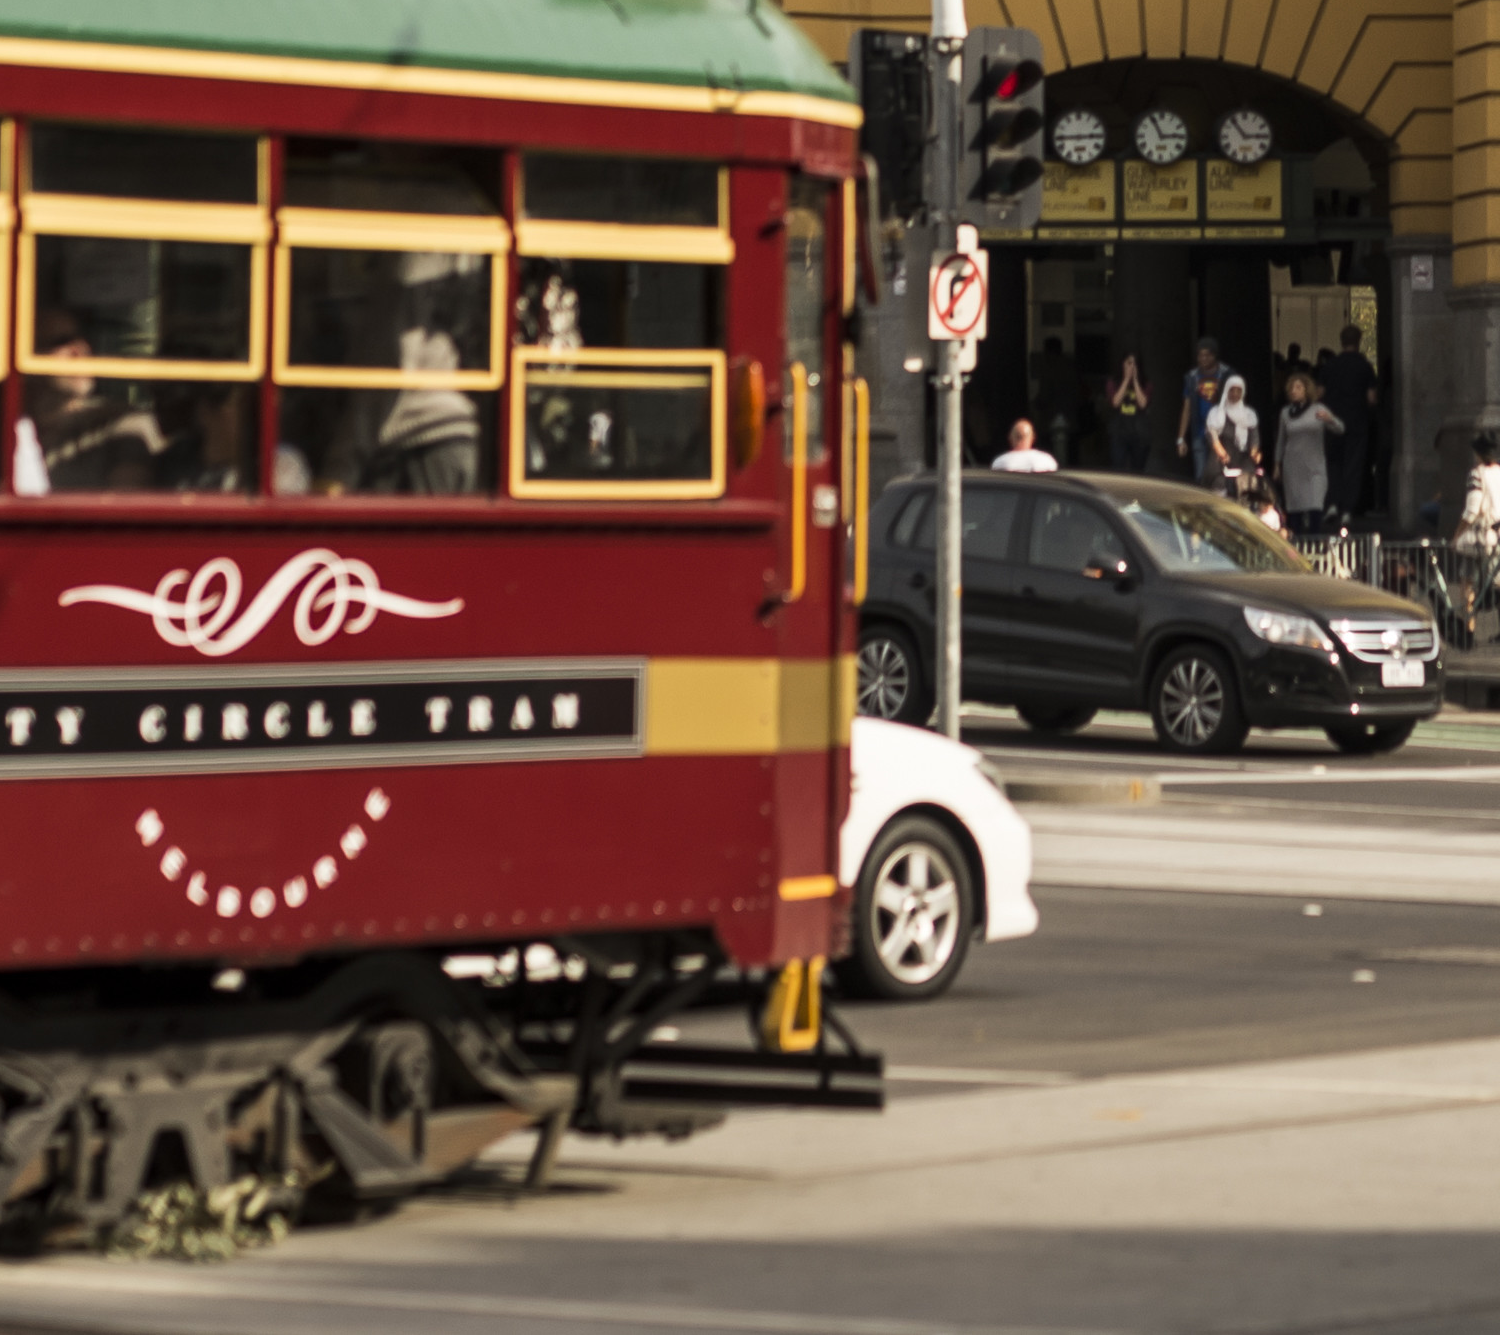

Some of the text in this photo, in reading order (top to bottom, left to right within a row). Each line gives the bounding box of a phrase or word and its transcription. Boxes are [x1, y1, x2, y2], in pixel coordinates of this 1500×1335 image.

[138, 699, 378, 744] CIRCLE
[426, 692, 583, 733] TRAM
[134, 786, 393, 919] MELBOURNE
